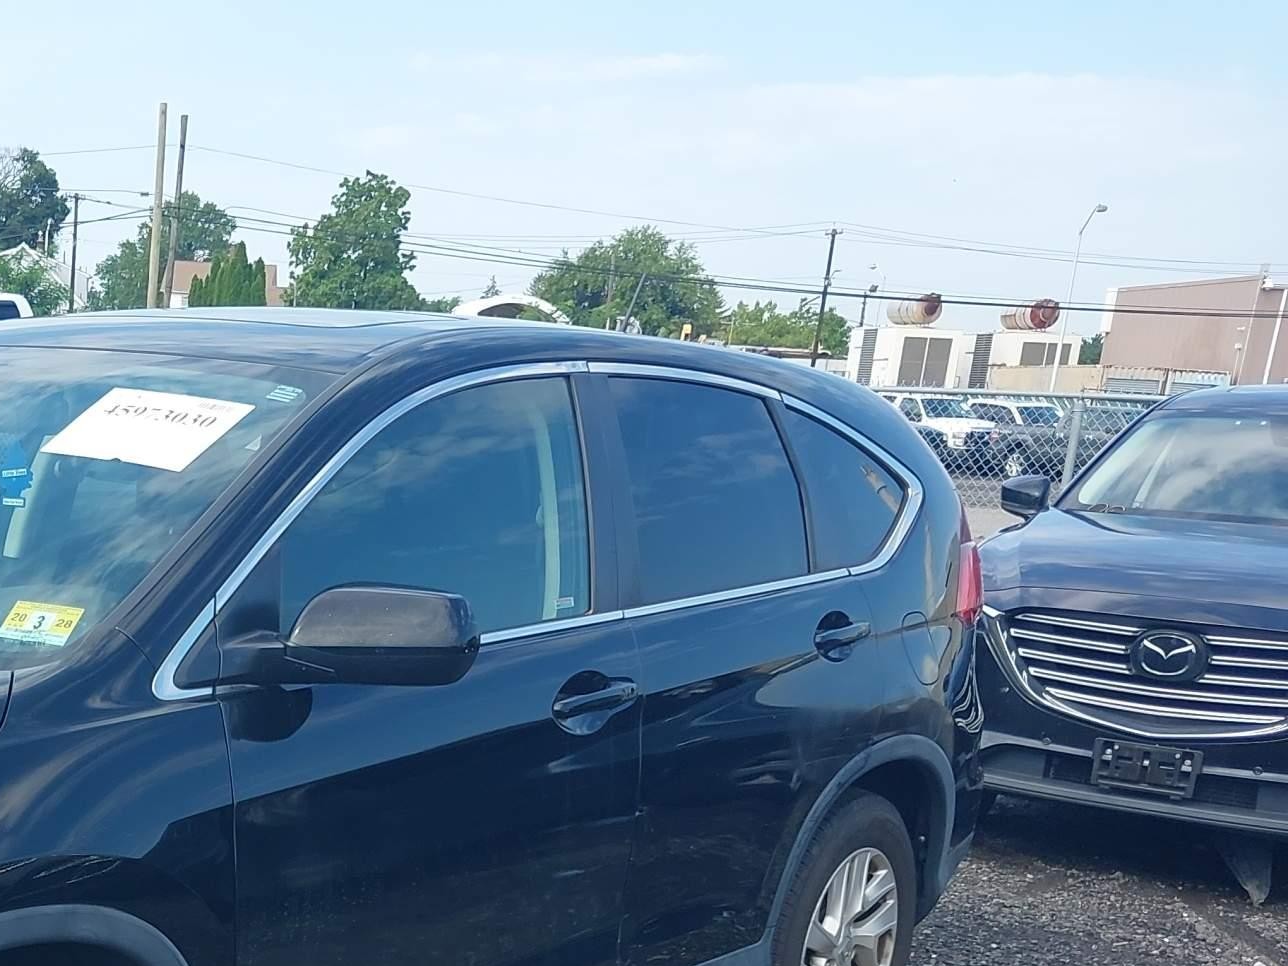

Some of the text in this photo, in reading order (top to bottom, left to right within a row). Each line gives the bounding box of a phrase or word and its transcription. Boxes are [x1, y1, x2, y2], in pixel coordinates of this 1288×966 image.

[11, 612, 73, 630] 20 3 28
